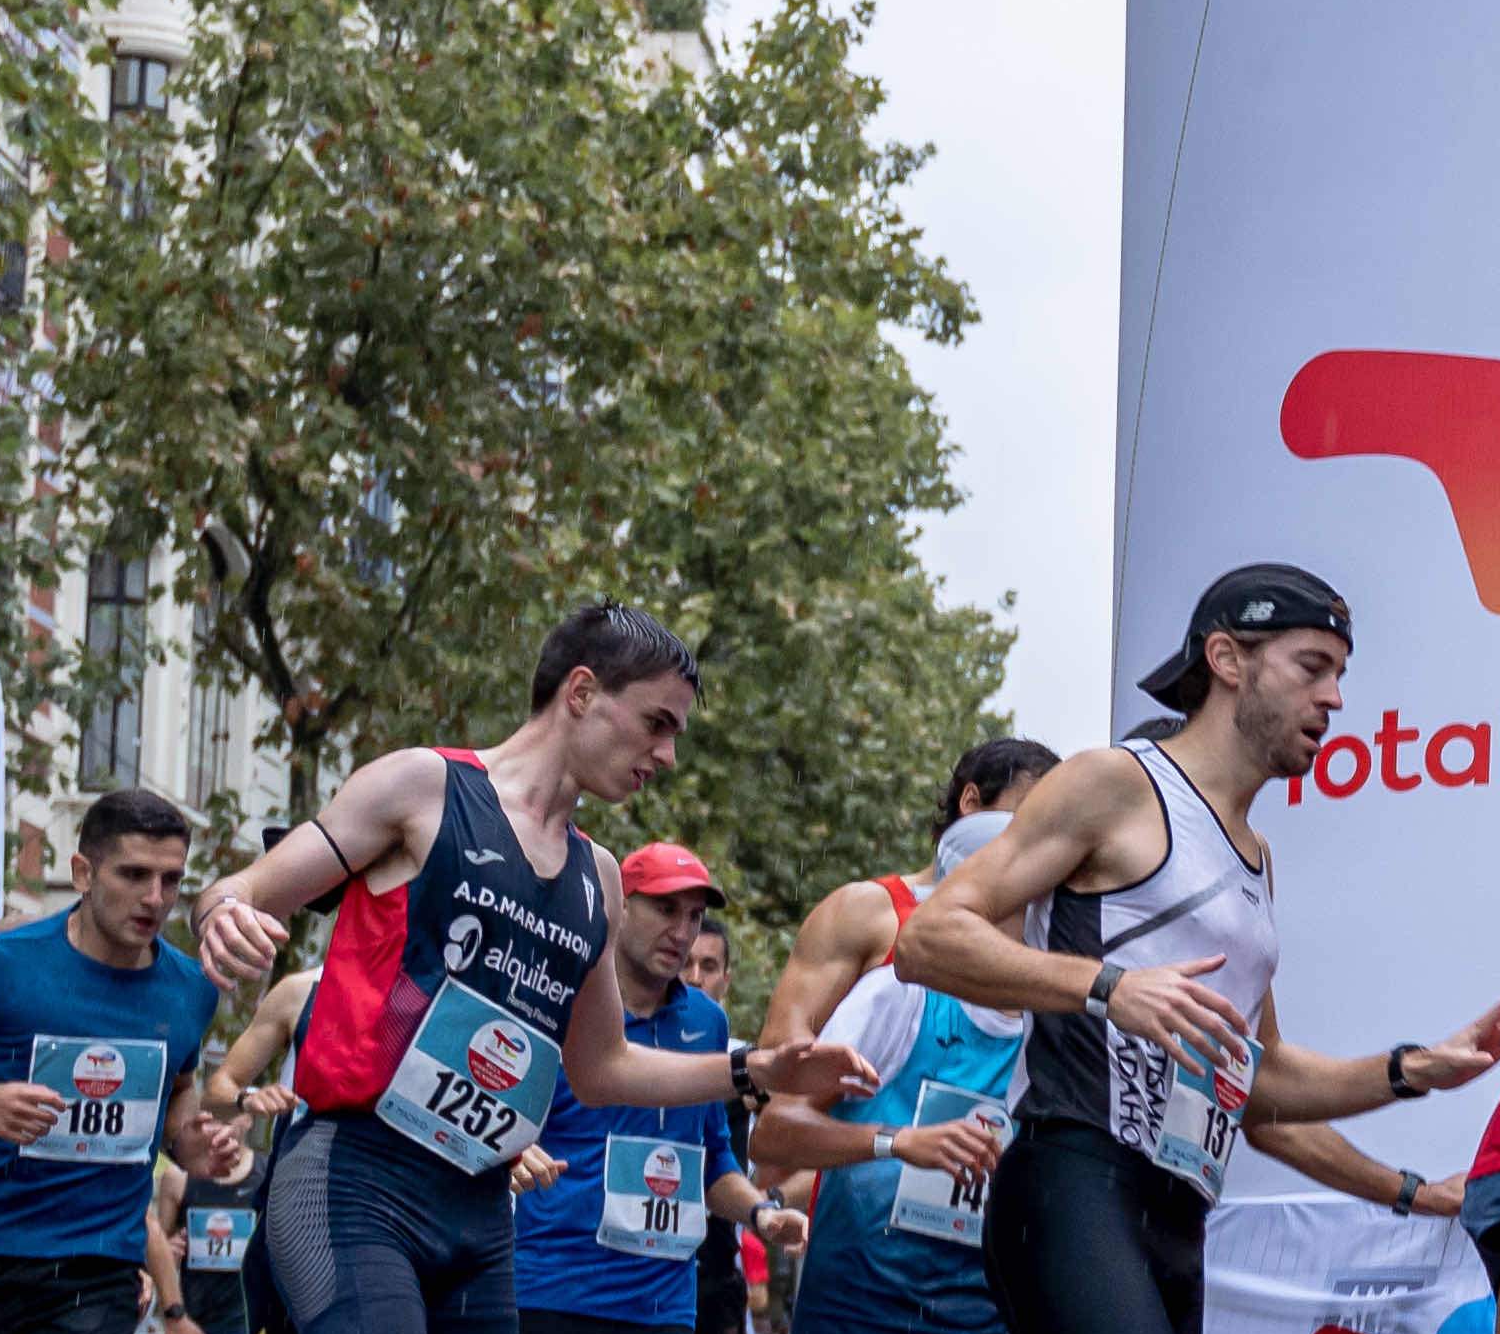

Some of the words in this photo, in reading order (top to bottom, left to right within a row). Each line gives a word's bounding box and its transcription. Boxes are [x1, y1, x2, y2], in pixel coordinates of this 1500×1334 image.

[484, 938, 575, 1006] alquiber
[66, 1099, 125, 1136] 188
[425, 1070, 518, 1153] 1252
[642, 1196, 680, 1235] 101
